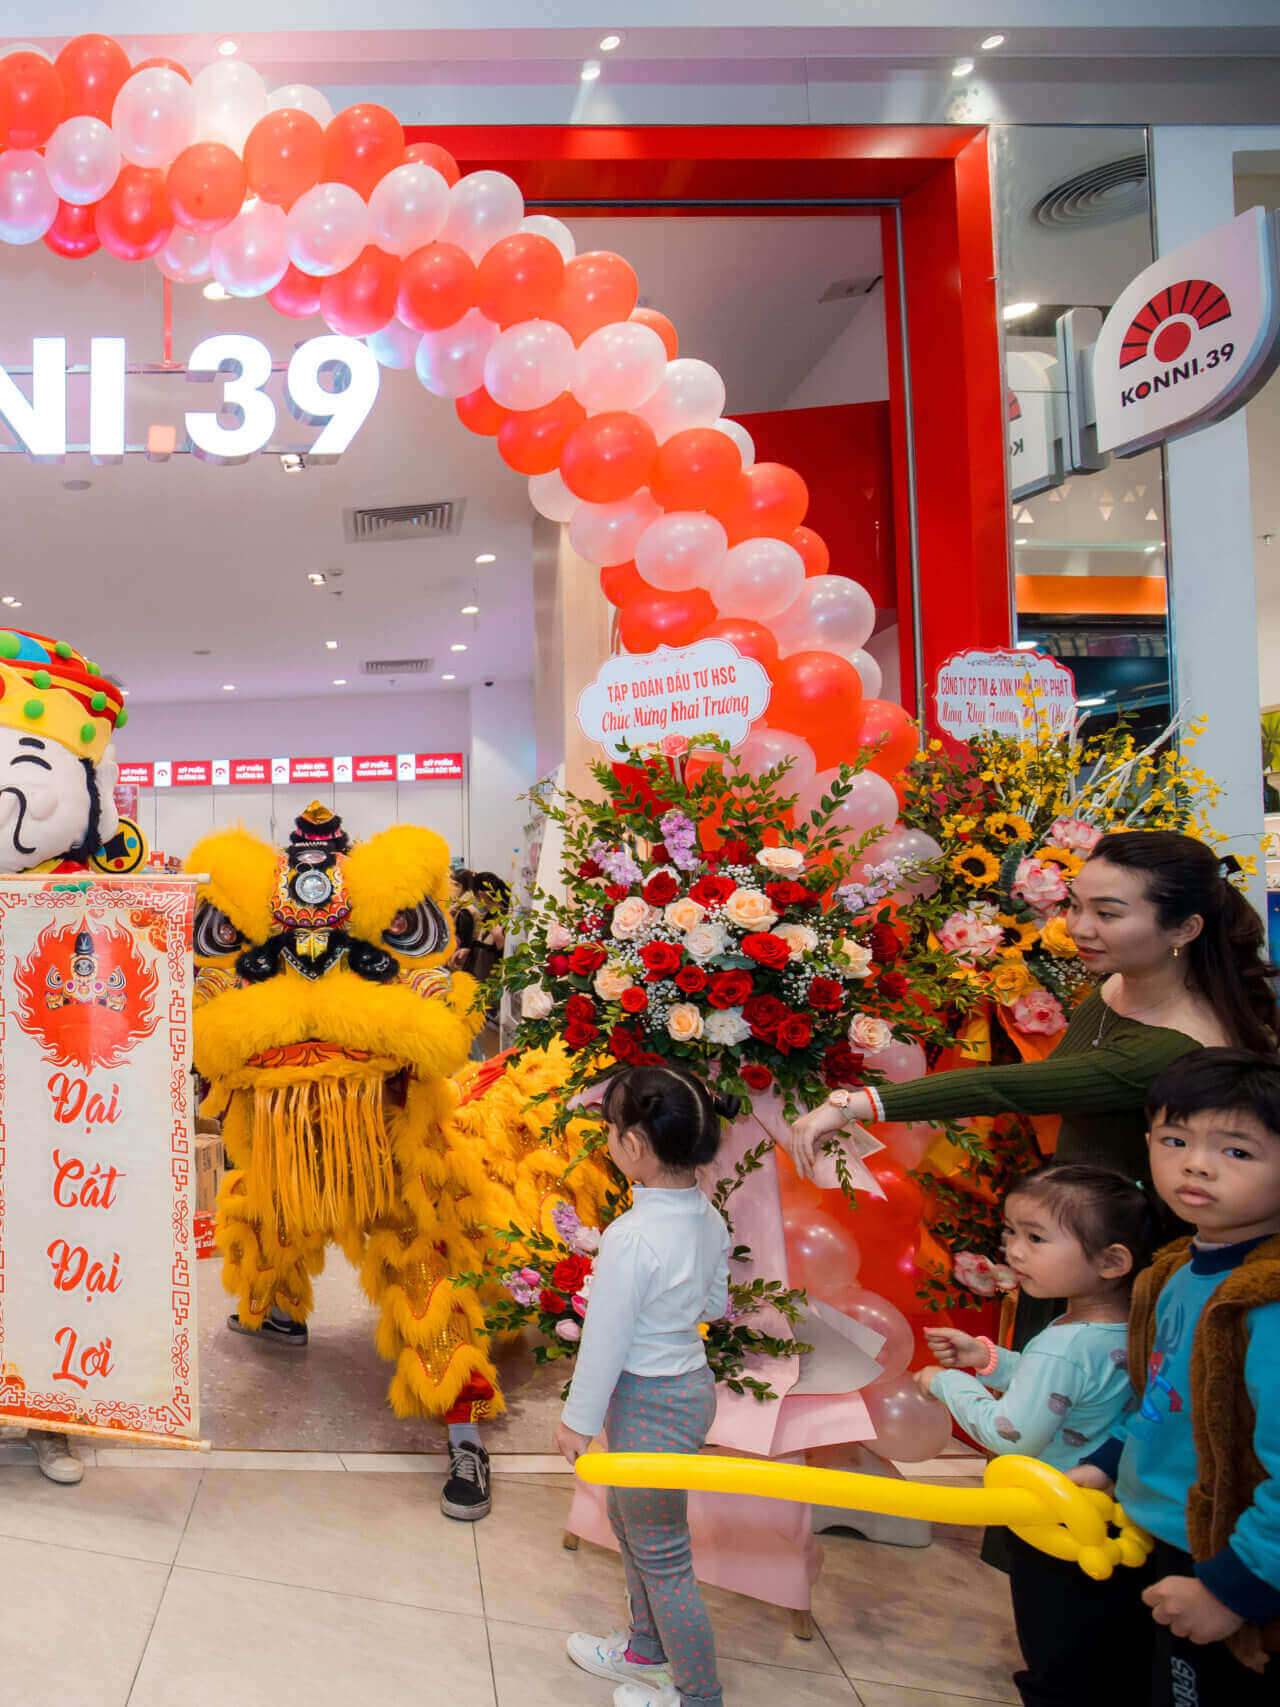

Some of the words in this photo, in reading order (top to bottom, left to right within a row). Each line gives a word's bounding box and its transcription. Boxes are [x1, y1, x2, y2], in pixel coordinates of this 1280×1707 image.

[1121, 343, 1235, 407] KONNI.39
[601, 708, 631, 732] Chúc
[633, 704, 668, 730] Mừng
[671, 699, 700, 722] Khai
[702, 695, 750, 718] Trương
[607, 681, 629, 706] TẬP
[632, 675, 665, 699] ĐOÀN
[667, 668, 691, 694] ĐẦU
[693, 667, 710, 689] TƯ
[711, 665, 737, 687] HSC
[959, 677, 967, 696] TY
[990, 677, 998, 696] &
[47, 1072, 122, 1134] Đại
[53, 1148, 127, 1209] Cát
[47, 1239, 122, 1303] Đại
